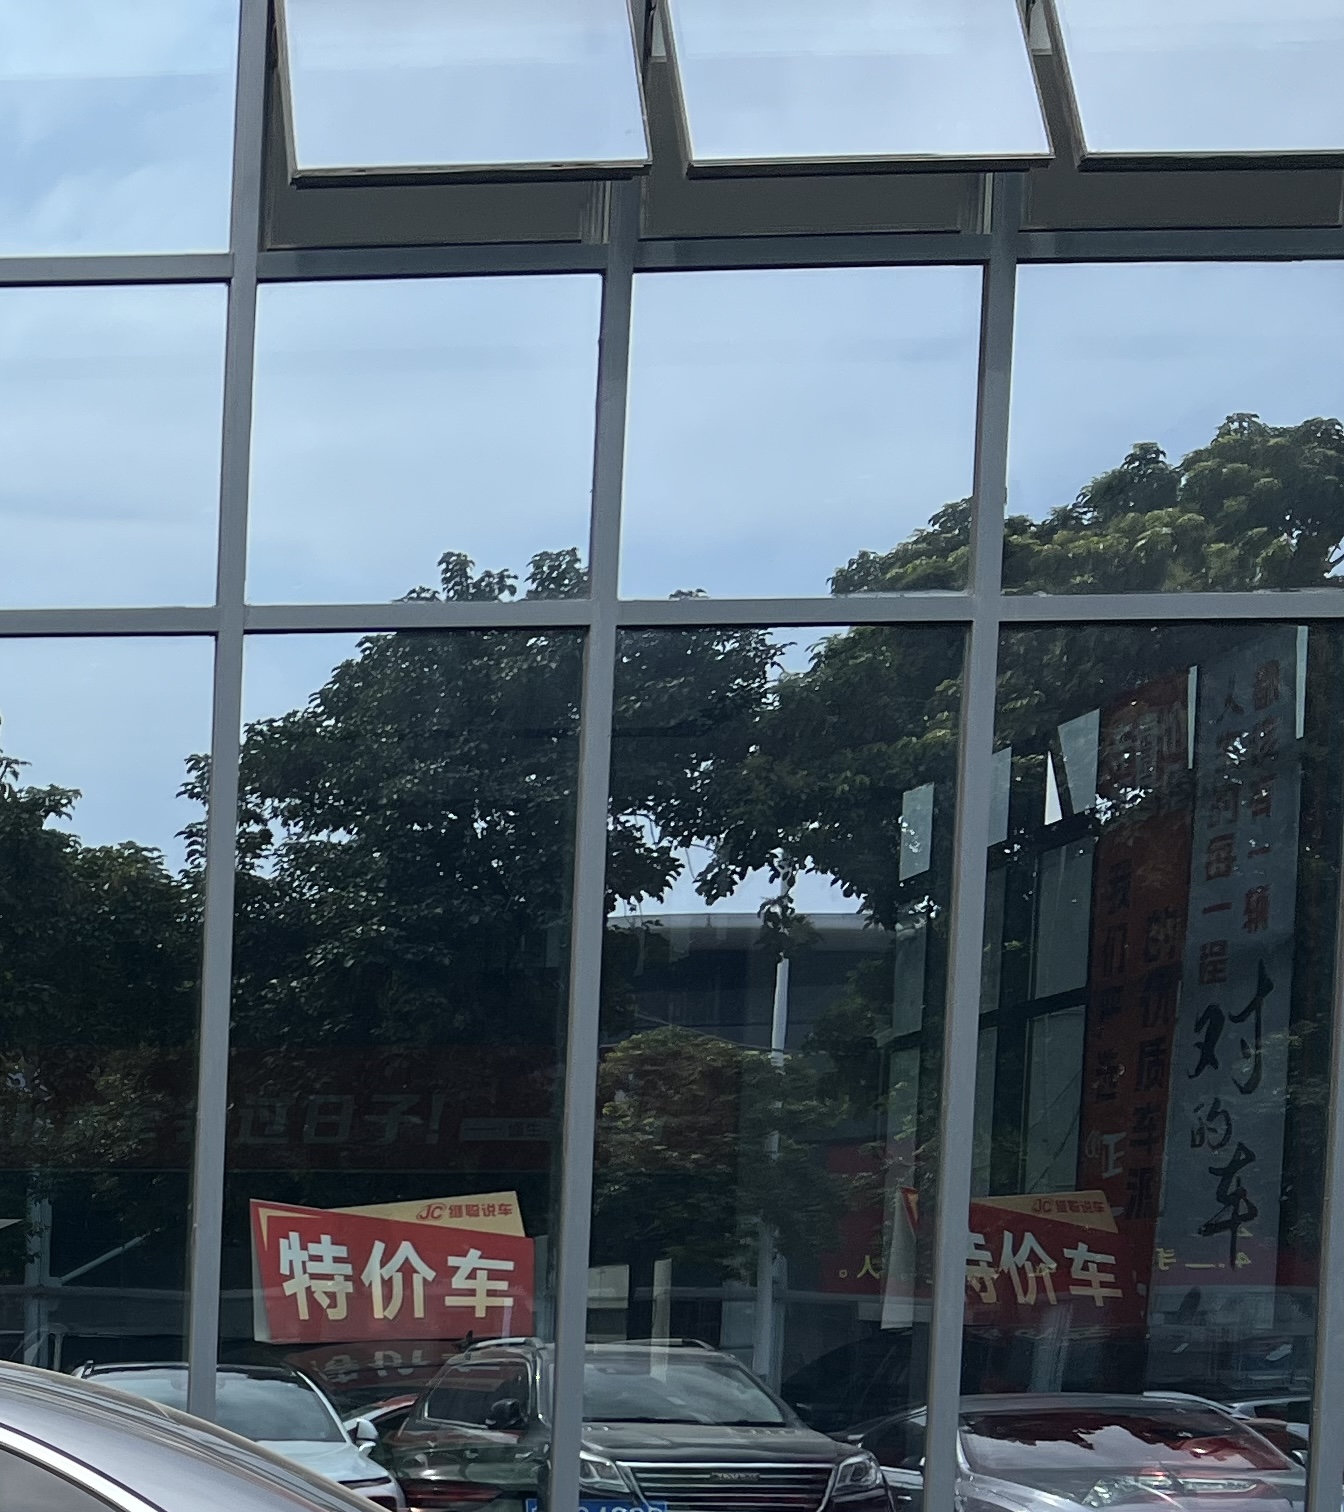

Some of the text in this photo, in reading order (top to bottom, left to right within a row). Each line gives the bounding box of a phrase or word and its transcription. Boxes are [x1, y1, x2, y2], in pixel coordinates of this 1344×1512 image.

[416, 1202, 447, 1221] JC
[279, 1231, 515, 1320] 特价车
